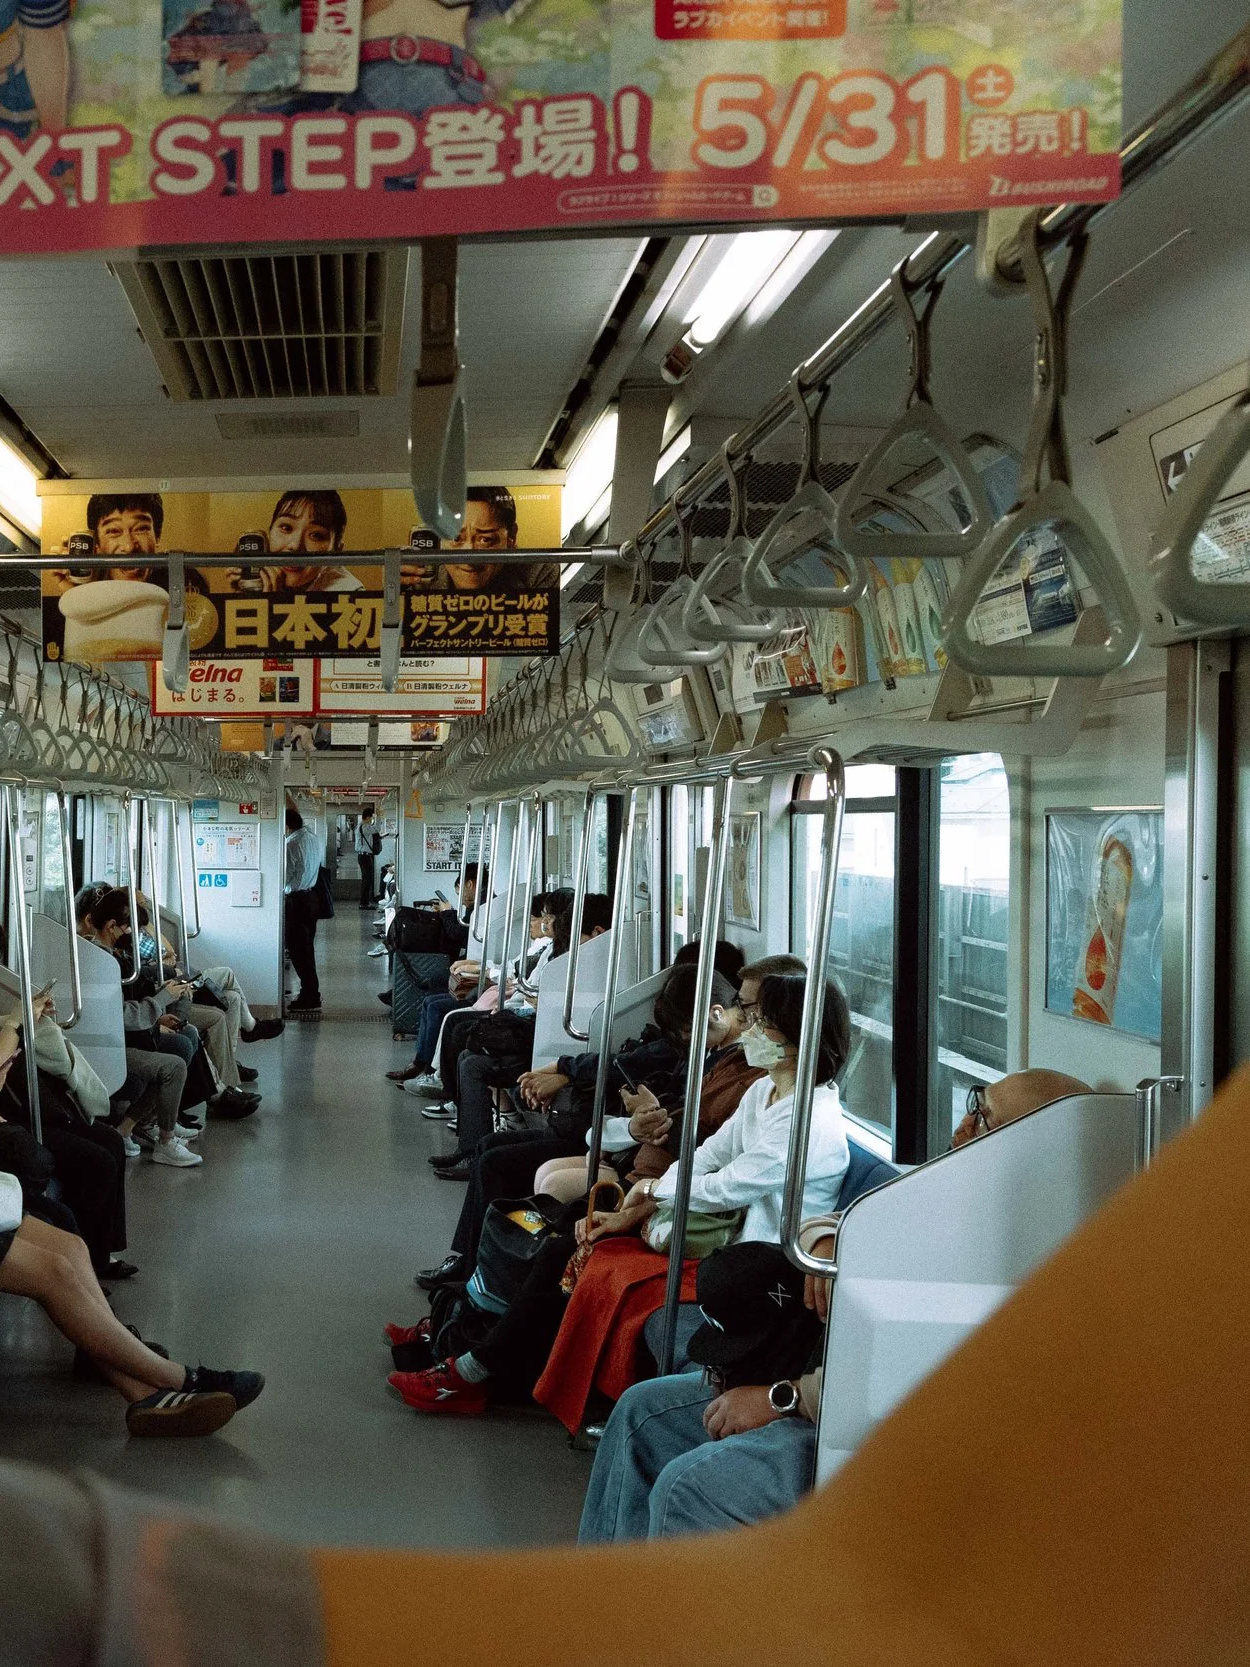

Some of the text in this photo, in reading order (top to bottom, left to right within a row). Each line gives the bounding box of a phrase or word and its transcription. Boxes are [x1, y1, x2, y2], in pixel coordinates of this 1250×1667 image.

[697, 73, 946, 168] 5/31
[969, 110, 1082, 156] 発売!
[70, 542, 89, 550] PSB
[239, 543, 259, 551] PSB
[412, 539, 434, 548] PSB
[410, 592, 549, 612] 糖質ゼロのビールが
[225, 594, 405, 650] 日本初
[410, 613, 549, 637] グランプリ受賞
[189, 664, 244, 683] elna
[414, 682, 468, 691] 日清製粉ウェルナ
[426, 861, 451, 869] START
